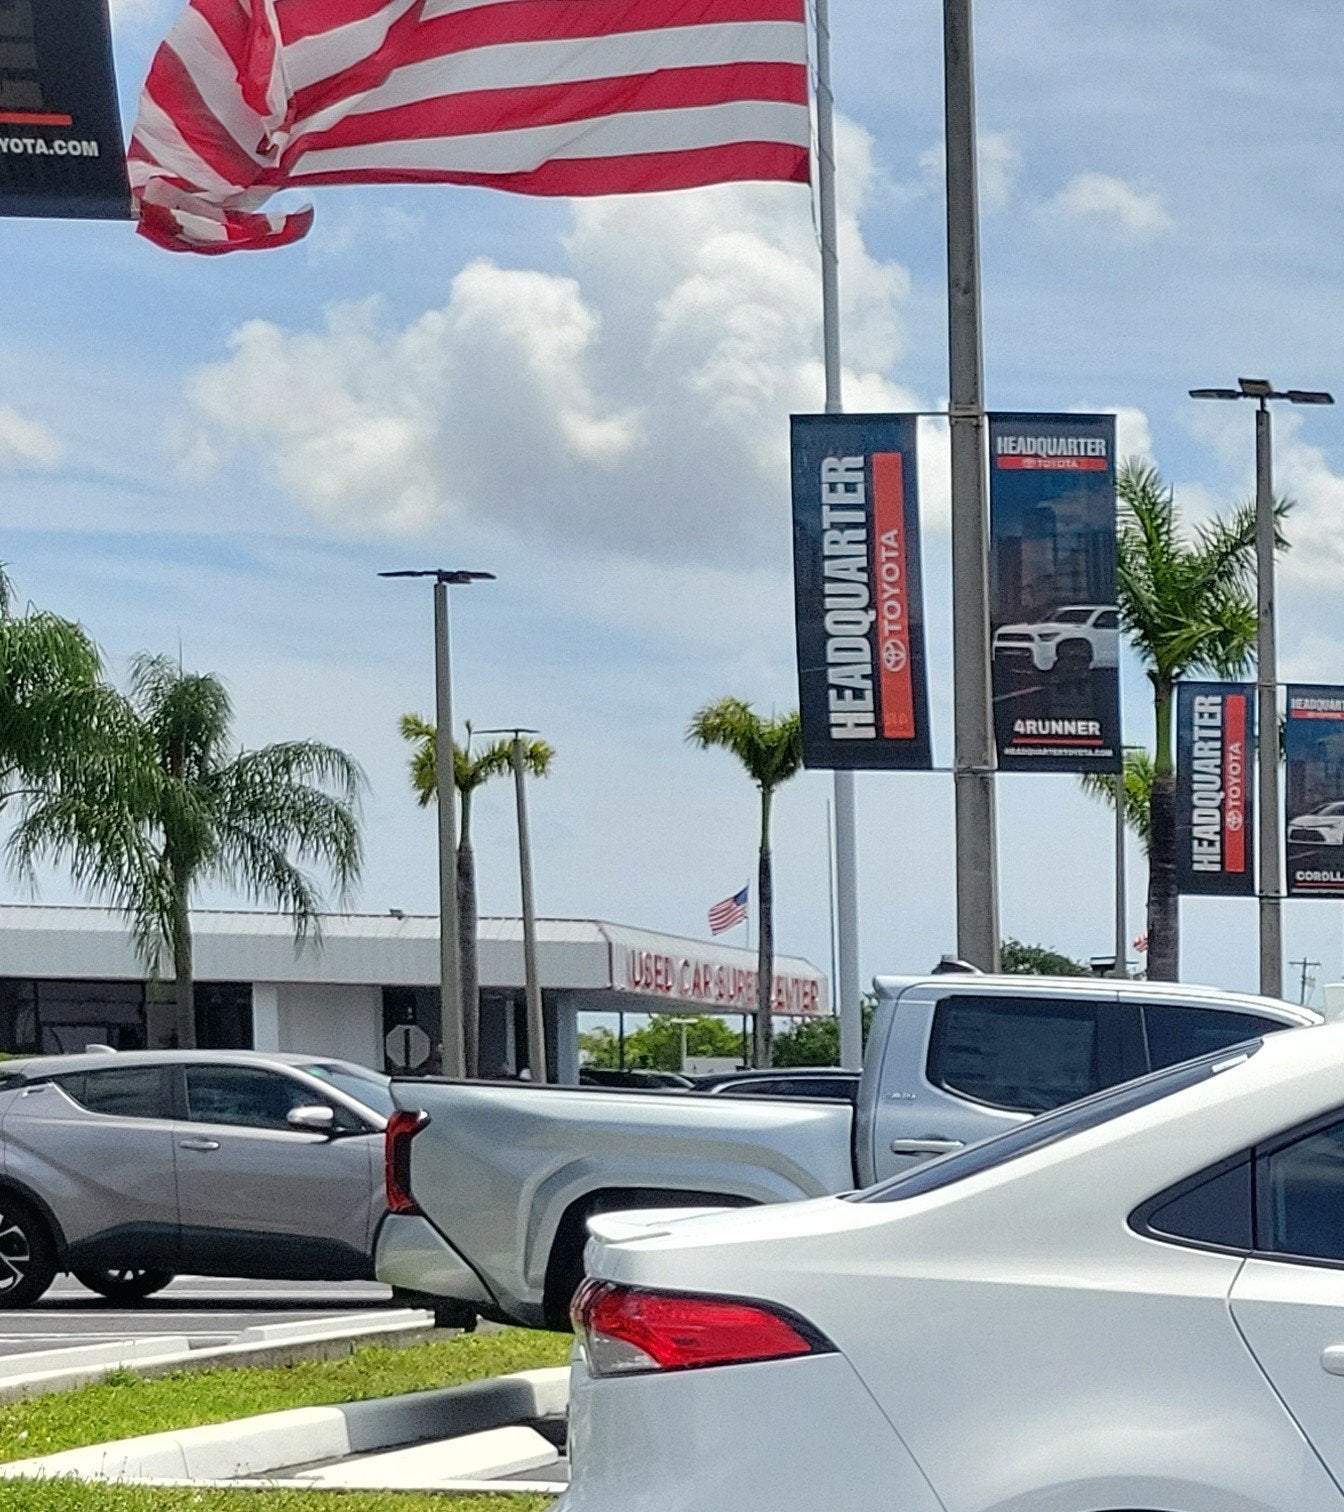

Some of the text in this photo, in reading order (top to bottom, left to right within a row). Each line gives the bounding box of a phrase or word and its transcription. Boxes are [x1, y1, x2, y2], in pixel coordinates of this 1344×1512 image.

[997, 436, 1107, 457] HEADQUARTER
[821, 456, 877, 740] HEADQUARTER
[881, 529, 906, 638] TOYOTA
[1013, 719, 1101, 736] 4RUNNER
[1192, 695, 1225, 872] HEADQUARTER
[1228, 742, 1242, 807] TOYOTA
[631, 950, 819, 1012] USED CAR SUPE ENTER
